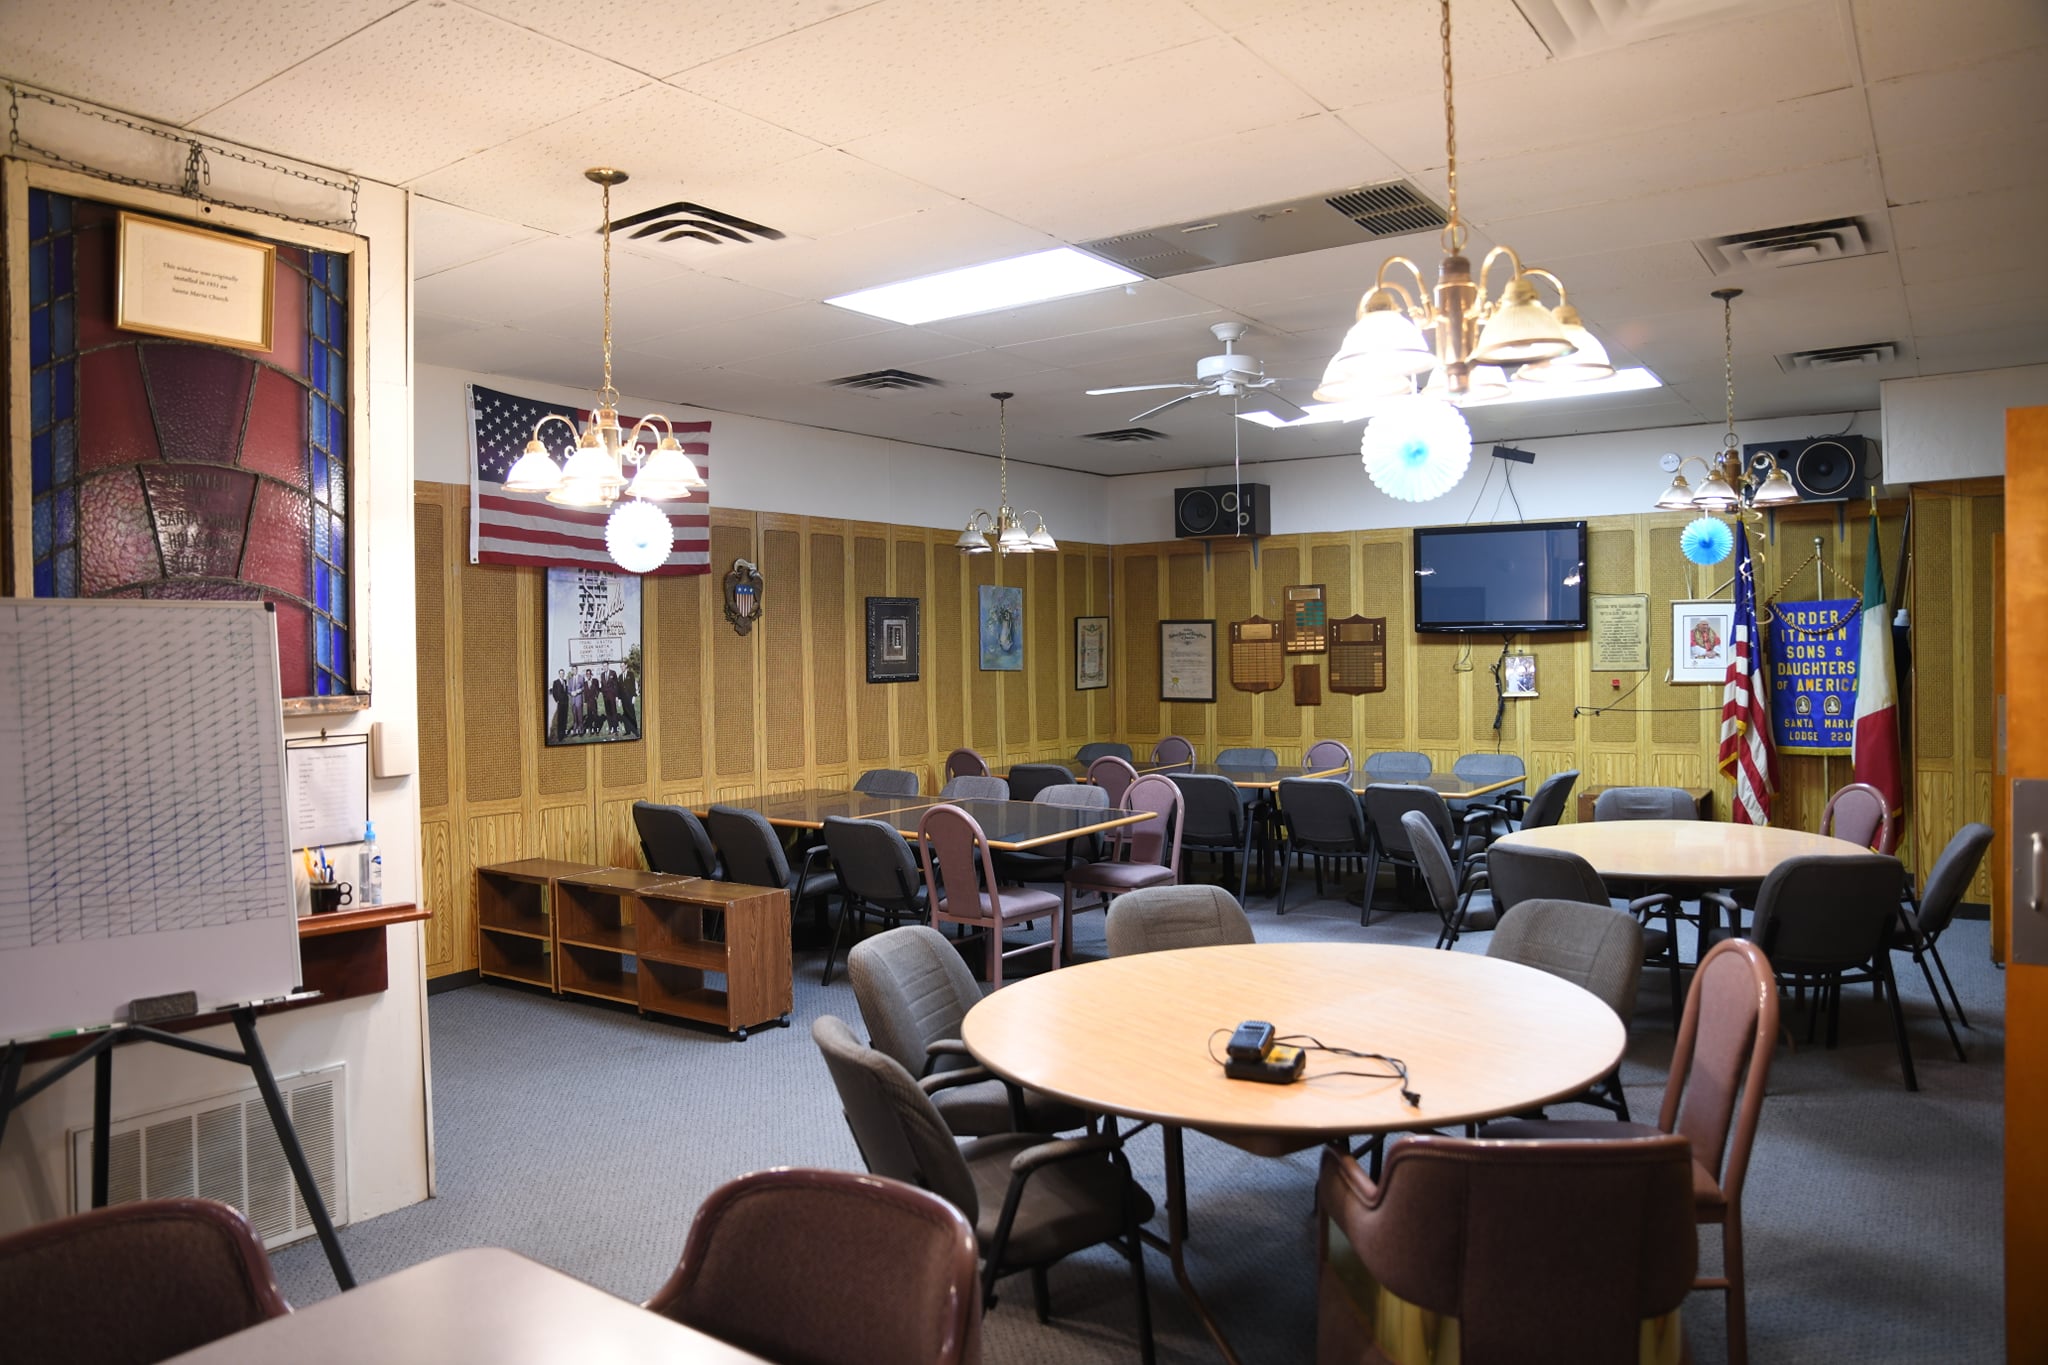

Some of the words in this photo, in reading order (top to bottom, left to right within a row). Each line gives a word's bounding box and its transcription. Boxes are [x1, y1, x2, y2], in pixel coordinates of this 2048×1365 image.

[162, 261, 176, 270] This
[176, 266, 199, 274] window
[211, 272, 239, 282] originally
[173, 275, 198, 284] installed
[172, 287, 189, 295] Santa
[190, 290, 207, 298] Maria
[208, 294, 229, 302] Church
[1787, 610, 1839, 625] ORDER
[1781, 627, 1847, 642] ITALIAN
[1786, 645, 1826, 659] SONS
[1835, 647, 1843, 656] &
[1777, 661, 1856, 676] DAUGHTERS
[1777, 681, 1788, 690] OF
[1784, 719, 1814, 728] SANTA
[1824, 719, 1855, 728] MARIA
[1789, 732, 1818, 741] LODGE
